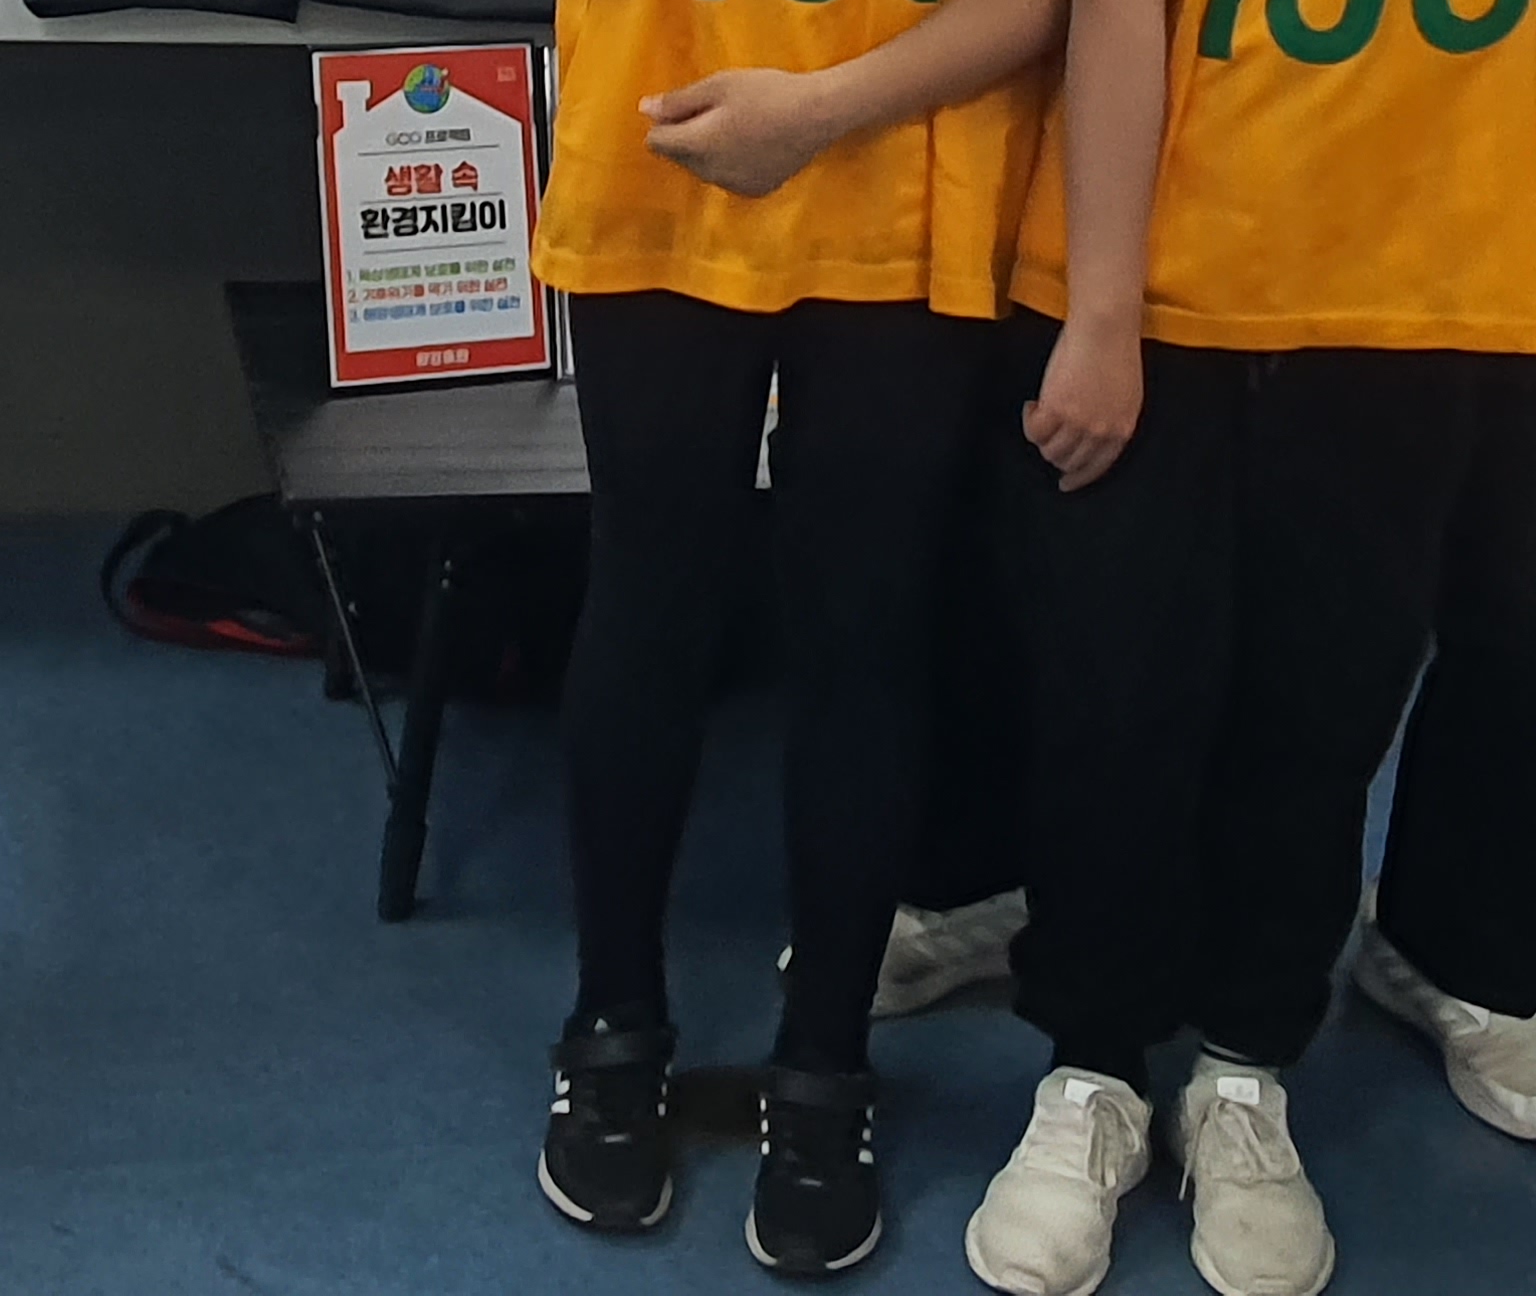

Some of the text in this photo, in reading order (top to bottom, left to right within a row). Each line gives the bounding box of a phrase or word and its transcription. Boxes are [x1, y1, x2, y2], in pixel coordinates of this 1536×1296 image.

[385, 161, 478, 196] 생활 속
[361, 199, 507, 239] 환경지킴이
